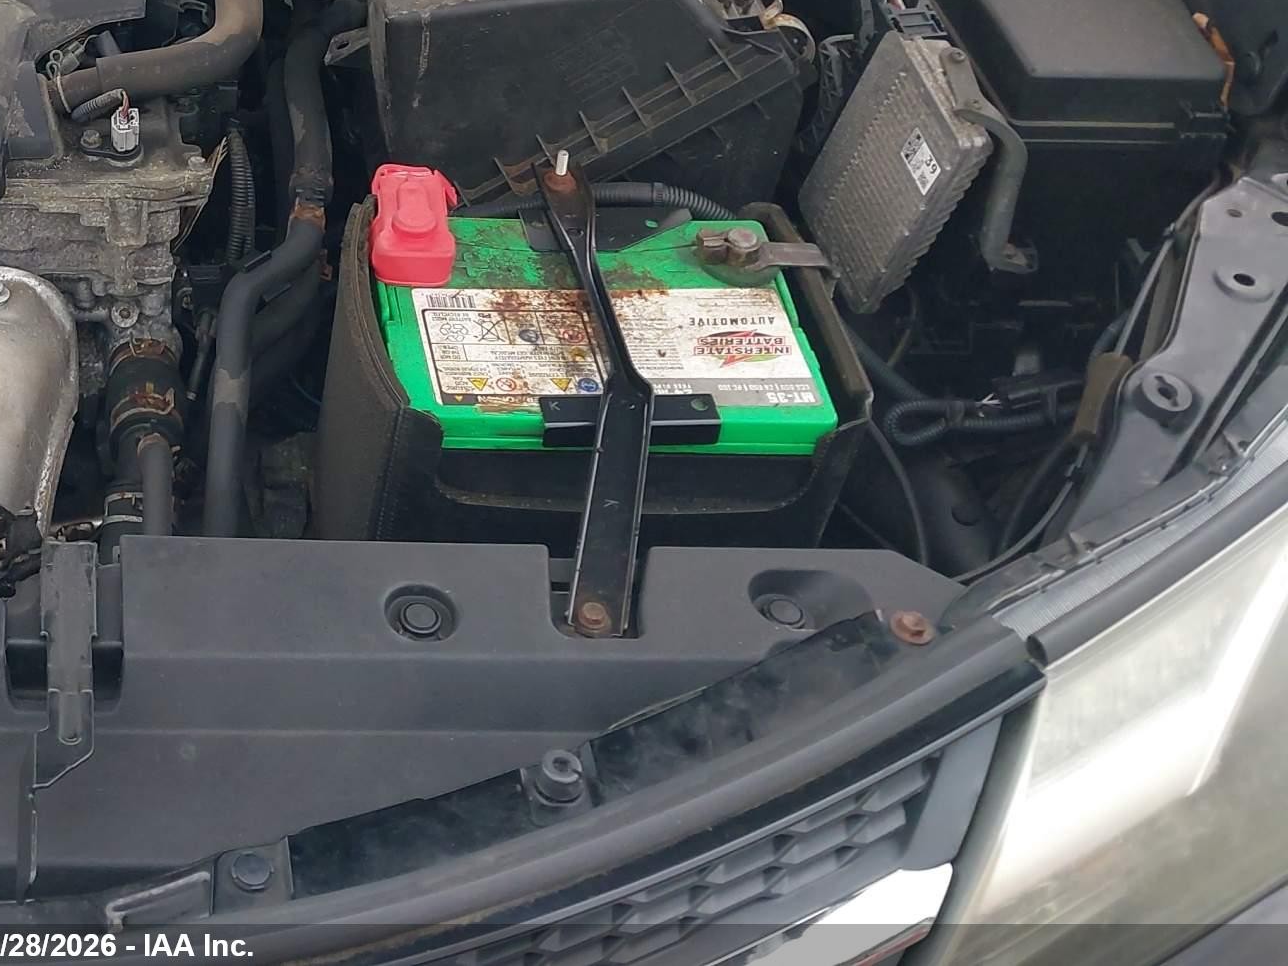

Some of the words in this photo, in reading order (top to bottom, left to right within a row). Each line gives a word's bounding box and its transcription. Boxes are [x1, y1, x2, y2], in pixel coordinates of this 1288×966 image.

[688, 316, 775, 327] AUTOMOTIVE
[699, 337, 784, 346] BATTERIES
[695, 346, 791, 356] INTERSTATE
[766, 391, 816, 403] MT-35
